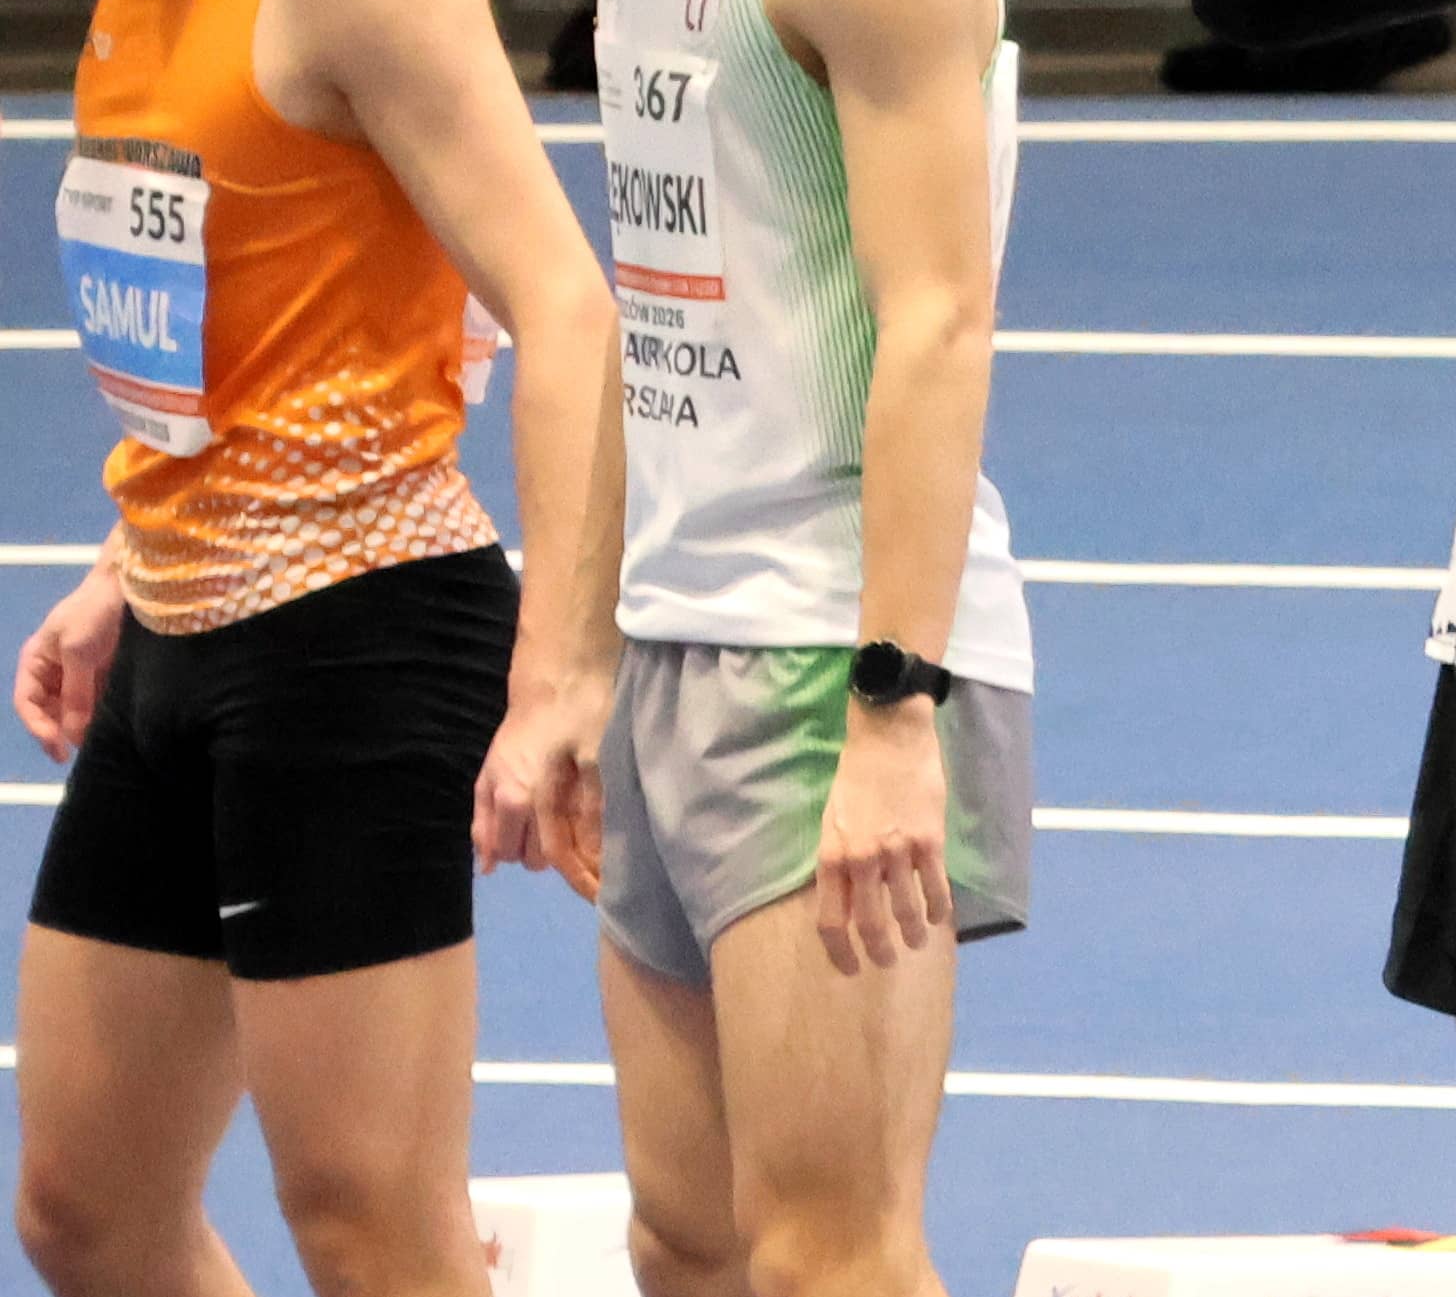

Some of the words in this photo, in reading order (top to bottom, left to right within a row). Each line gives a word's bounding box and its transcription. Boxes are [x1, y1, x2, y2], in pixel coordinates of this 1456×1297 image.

[634, 64, 692, 123] 367
[129, 185, 185, 243] 555
[80, 273, 178, 352] SAMUL
[651, 306, 685, 329] 2026
